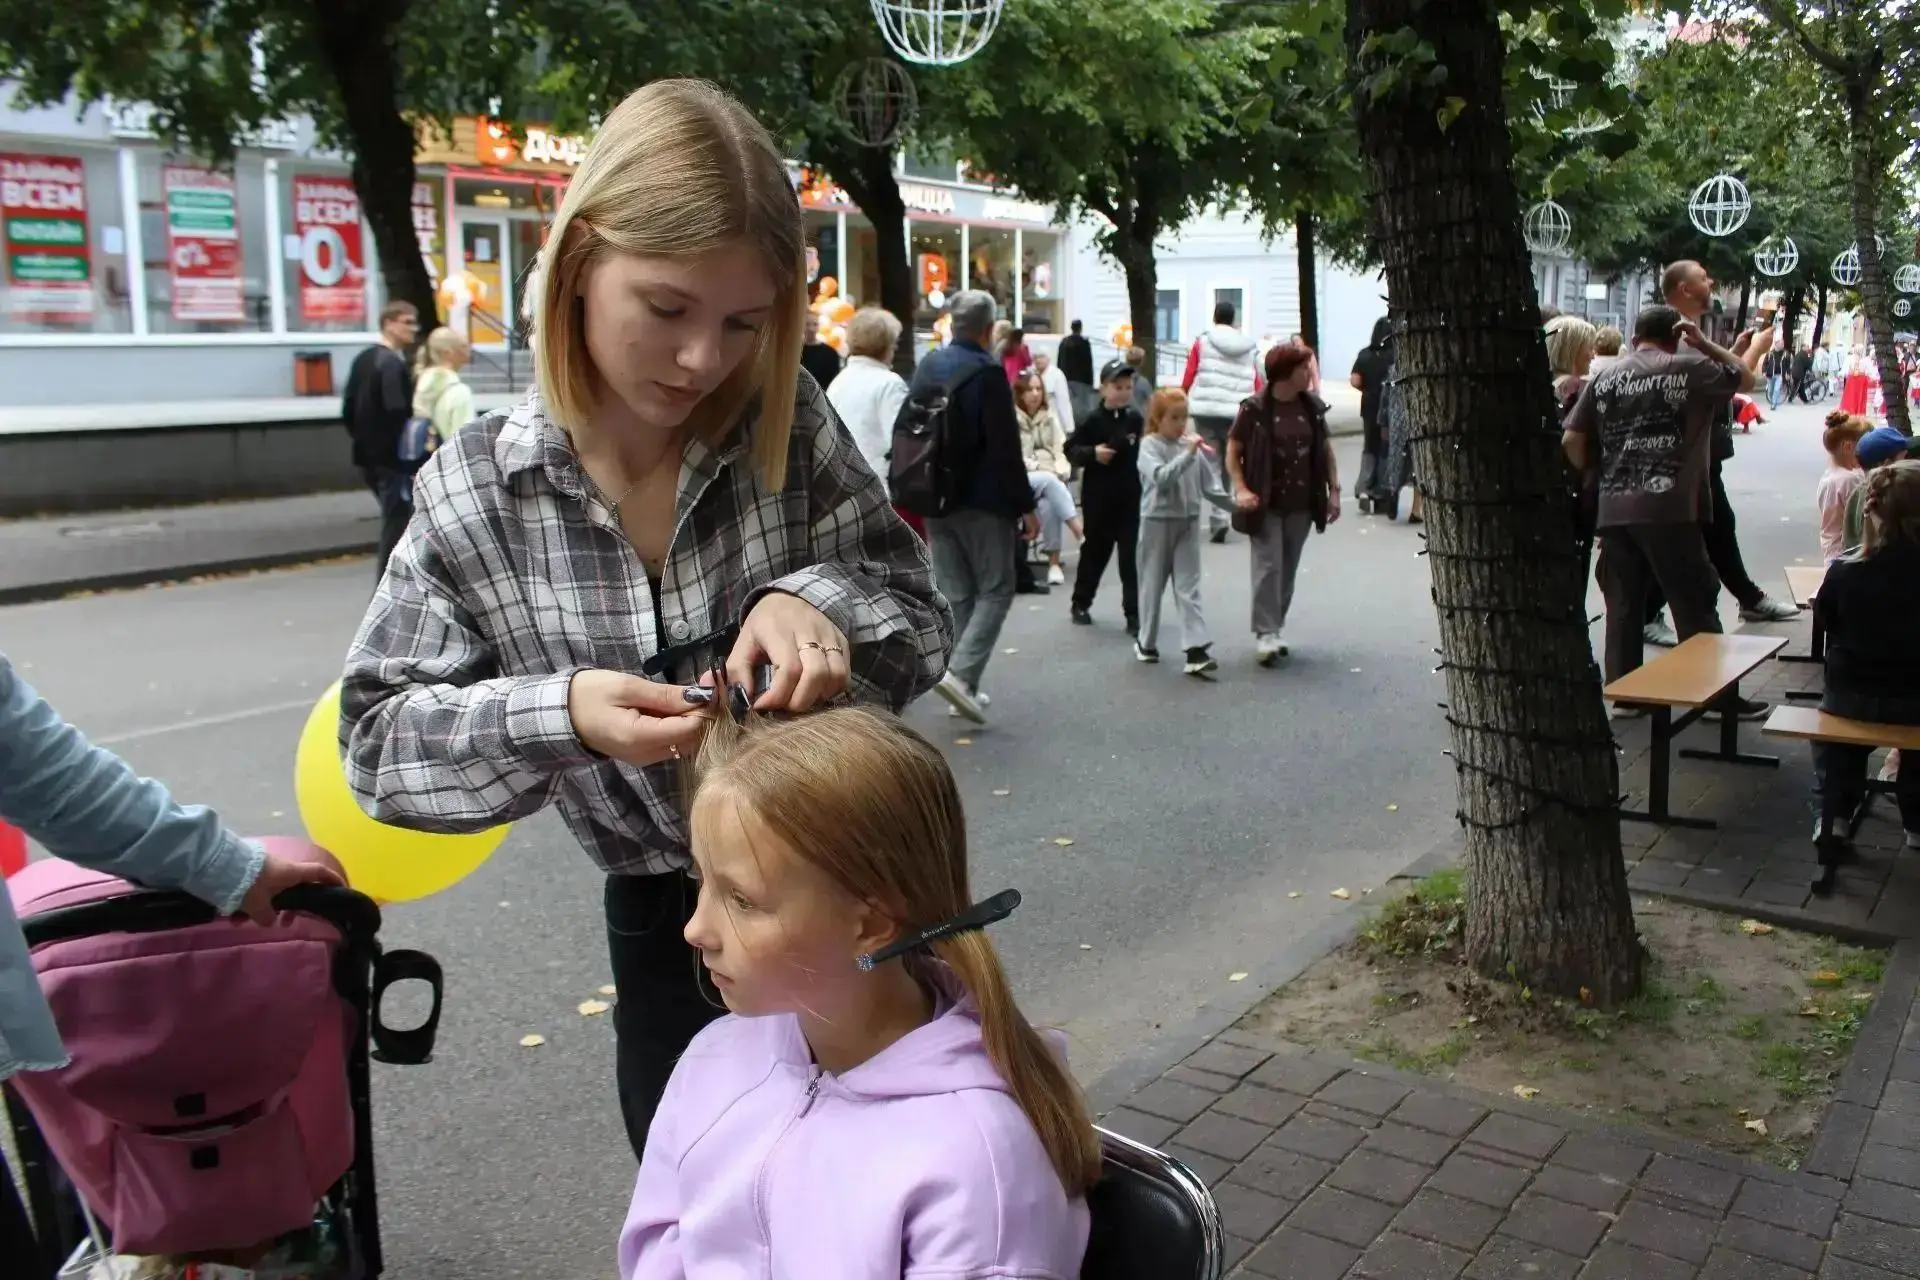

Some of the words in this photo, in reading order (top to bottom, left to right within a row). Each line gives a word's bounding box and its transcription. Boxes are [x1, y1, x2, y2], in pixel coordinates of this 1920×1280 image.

[2, 181, 82, 209] ВСЕМ
[298, 200, 358, 224] ВСЕМ
[1595, 368, 1635, 397] ROCKY
[1616, 373, 1689, 396] MOUNTAIN
[1663, 389, 1689, 400] TOUR
